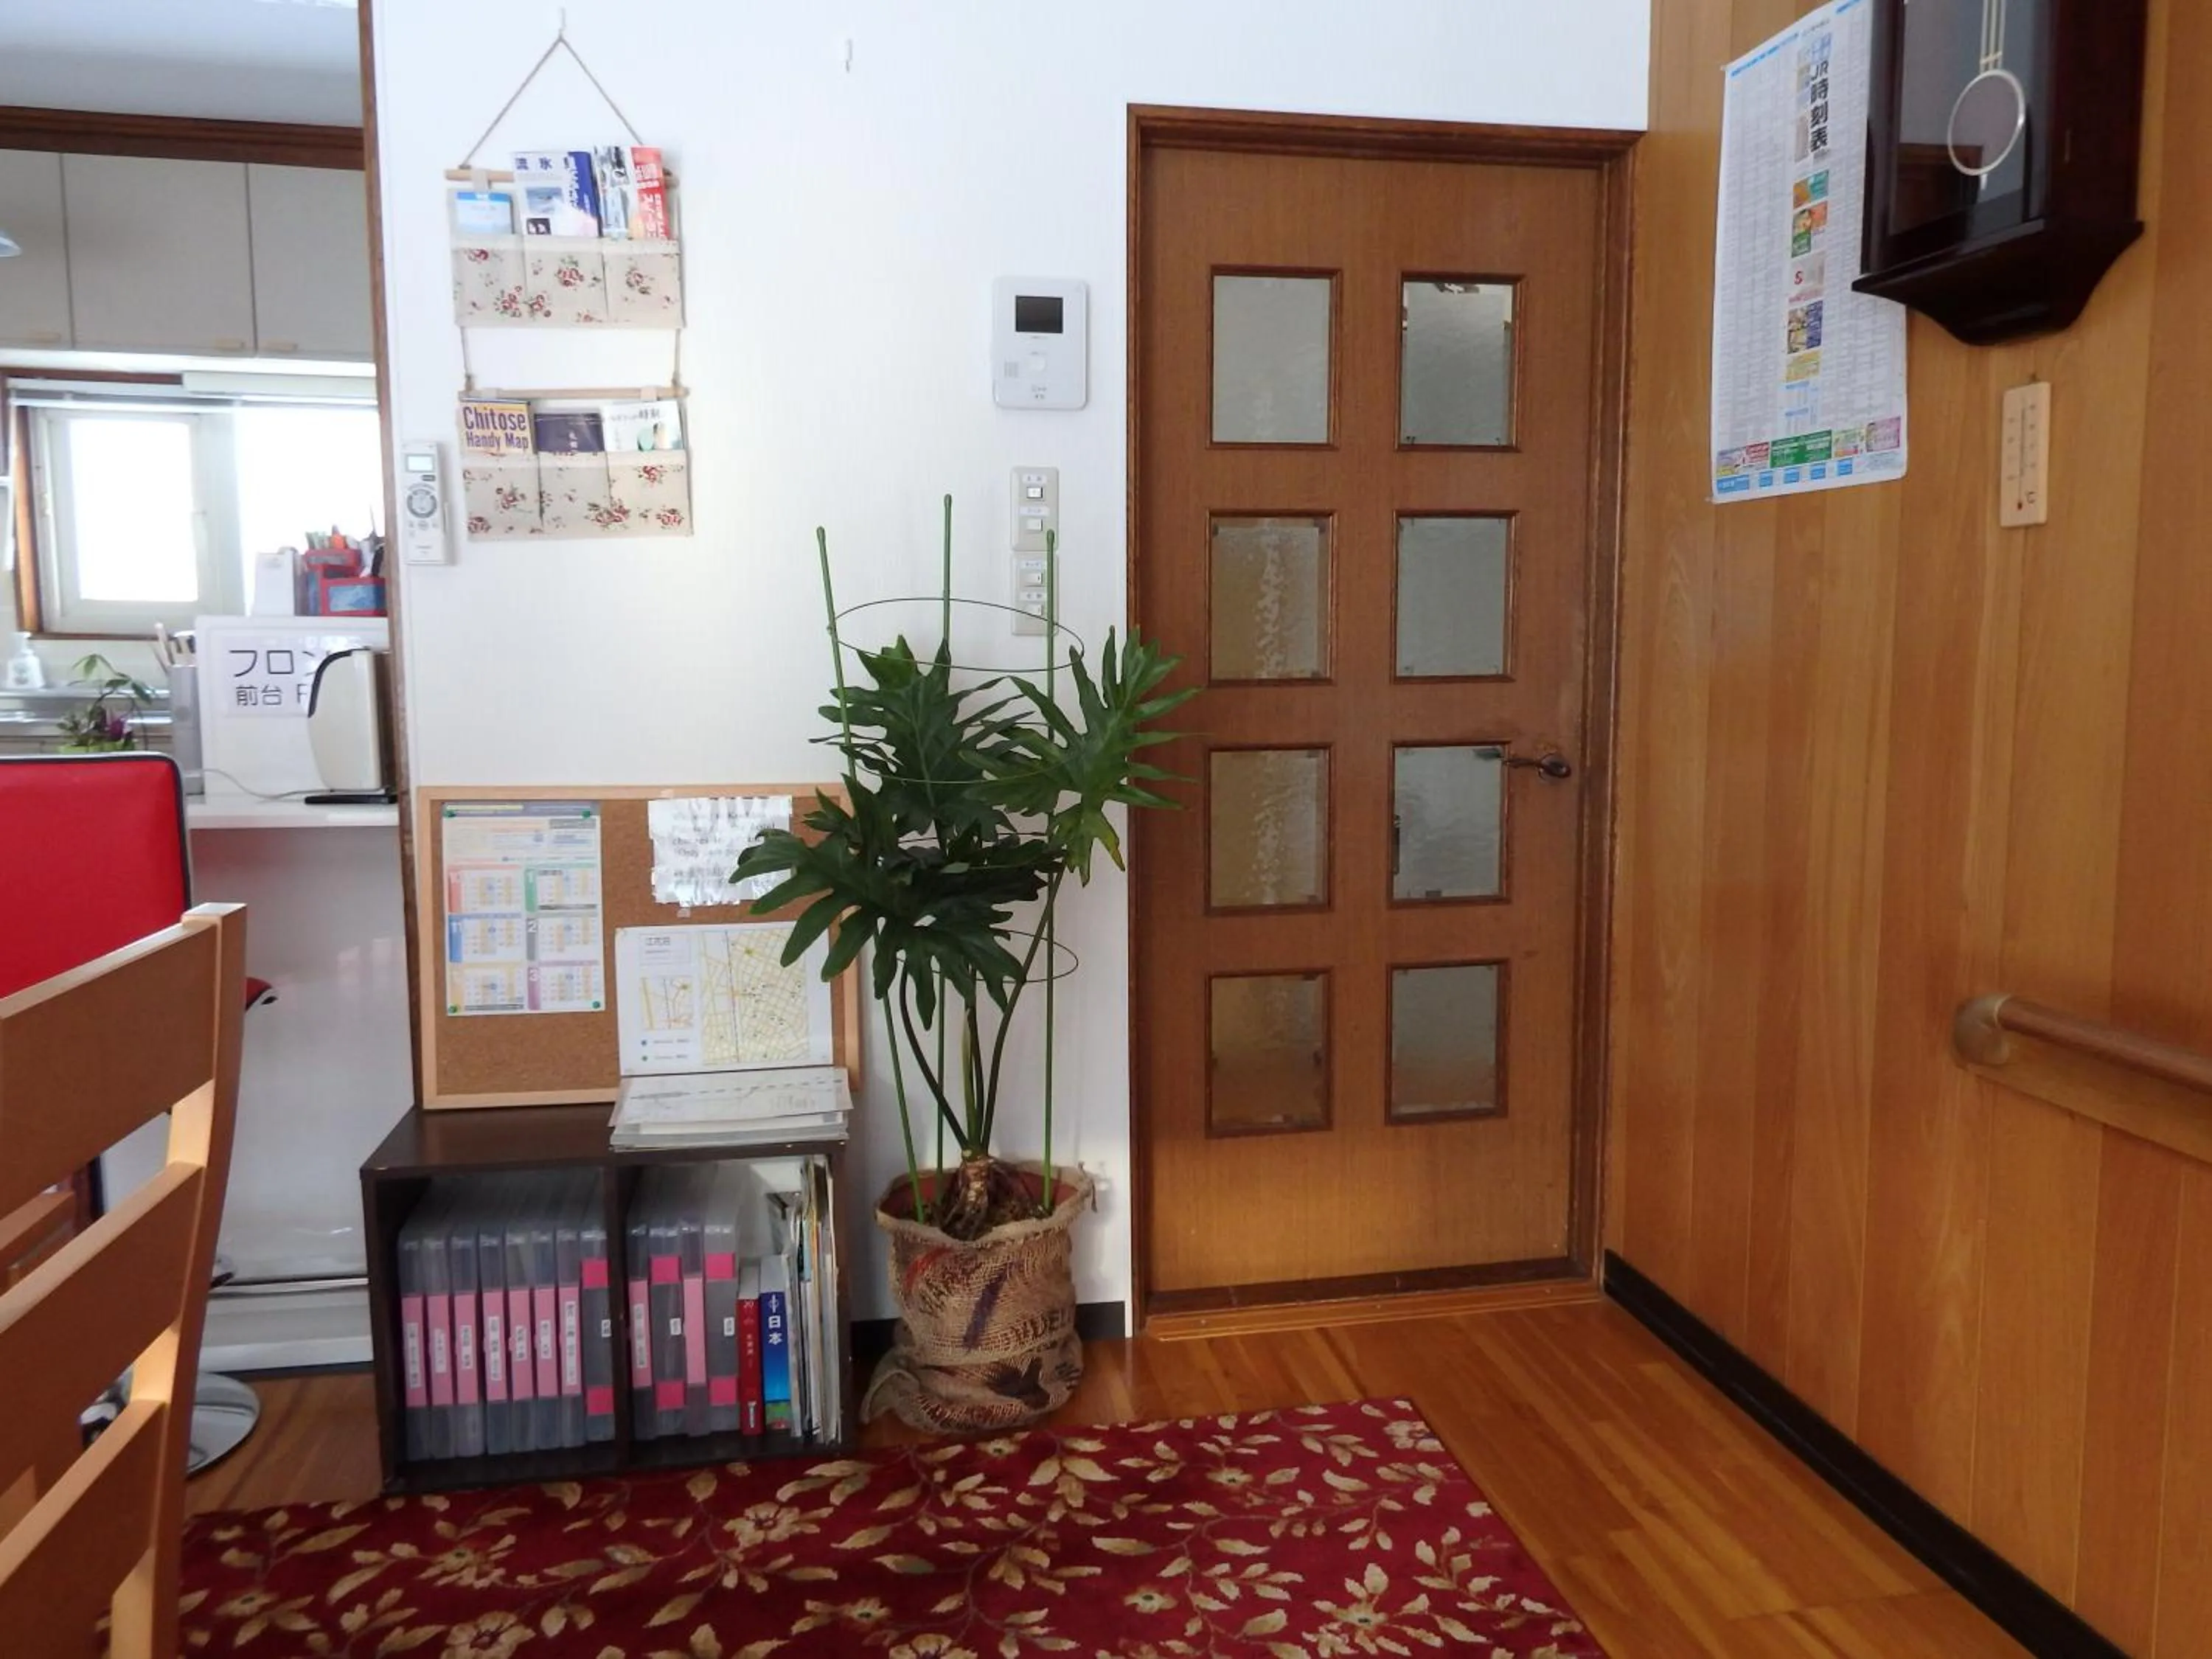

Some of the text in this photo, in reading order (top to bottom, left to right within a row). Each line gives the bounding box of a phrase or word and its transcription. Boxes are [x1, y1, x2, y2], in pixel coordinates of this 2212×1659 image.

[1810, 60, 1829, 153] JR時刻表
[462, 406, 526, 431] Chitose
[466, 432, 529, 451] Handy Map
[235, 685, 282, 706] 前台
